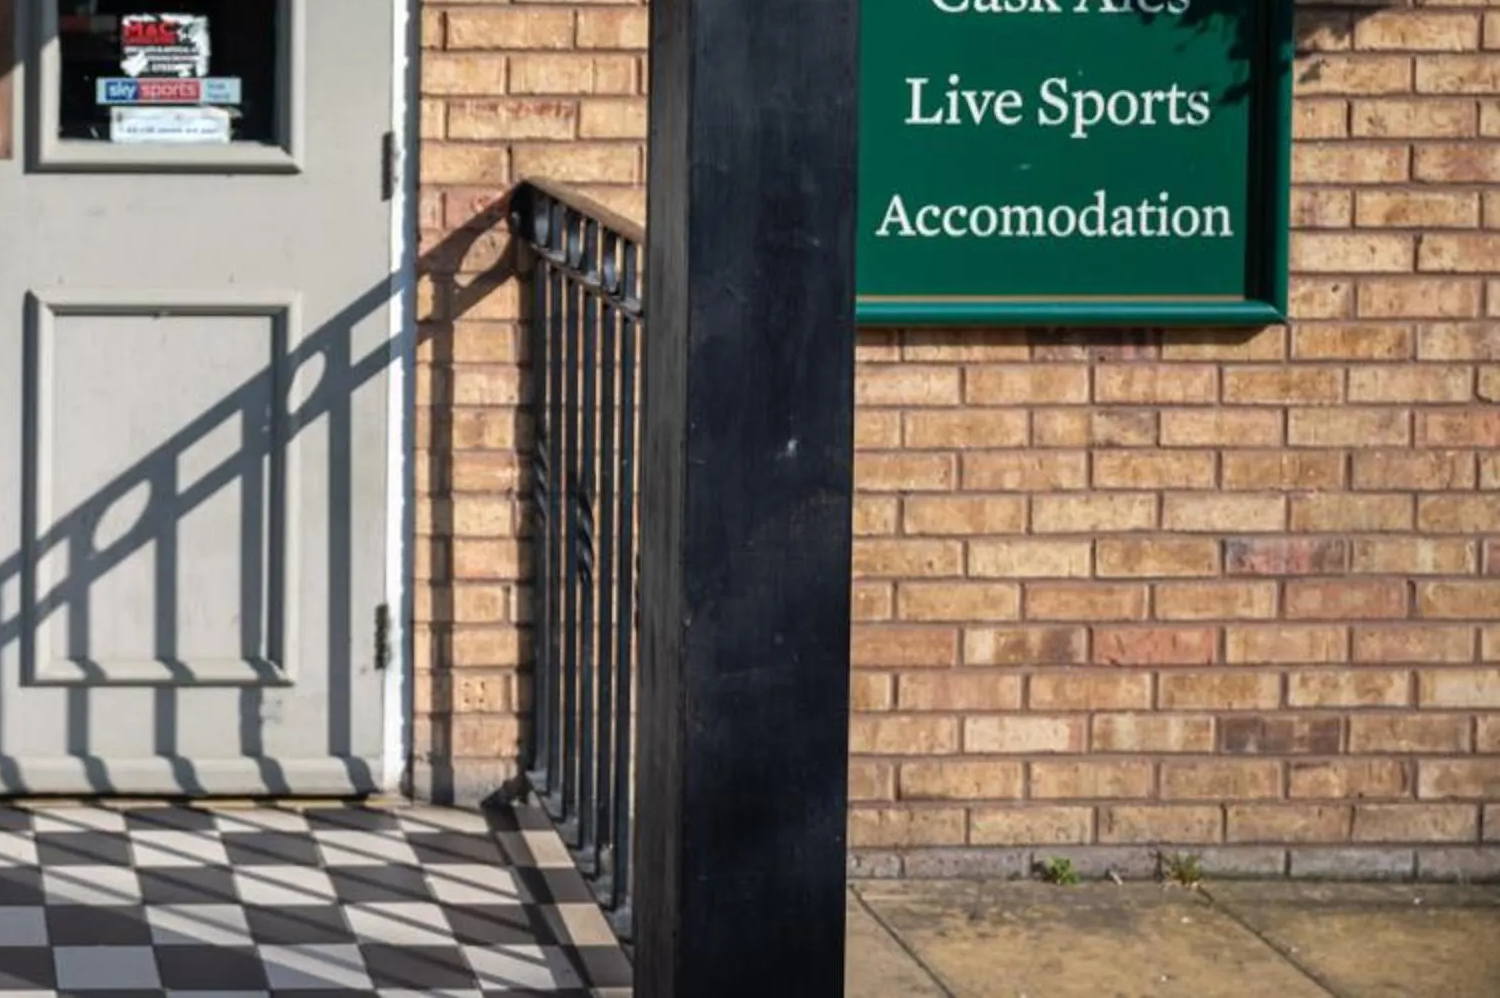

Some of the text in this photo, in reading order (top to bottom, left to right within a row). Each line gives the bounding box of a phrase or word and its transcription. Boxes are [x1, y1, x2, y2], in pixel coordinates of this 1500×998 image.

[107, 81, 137, 100] sky
[140, 82, 197, 101] sports
[904, 73, 1212, 139] Live Sports
[875, 191, 1235, 238] Accomodation
